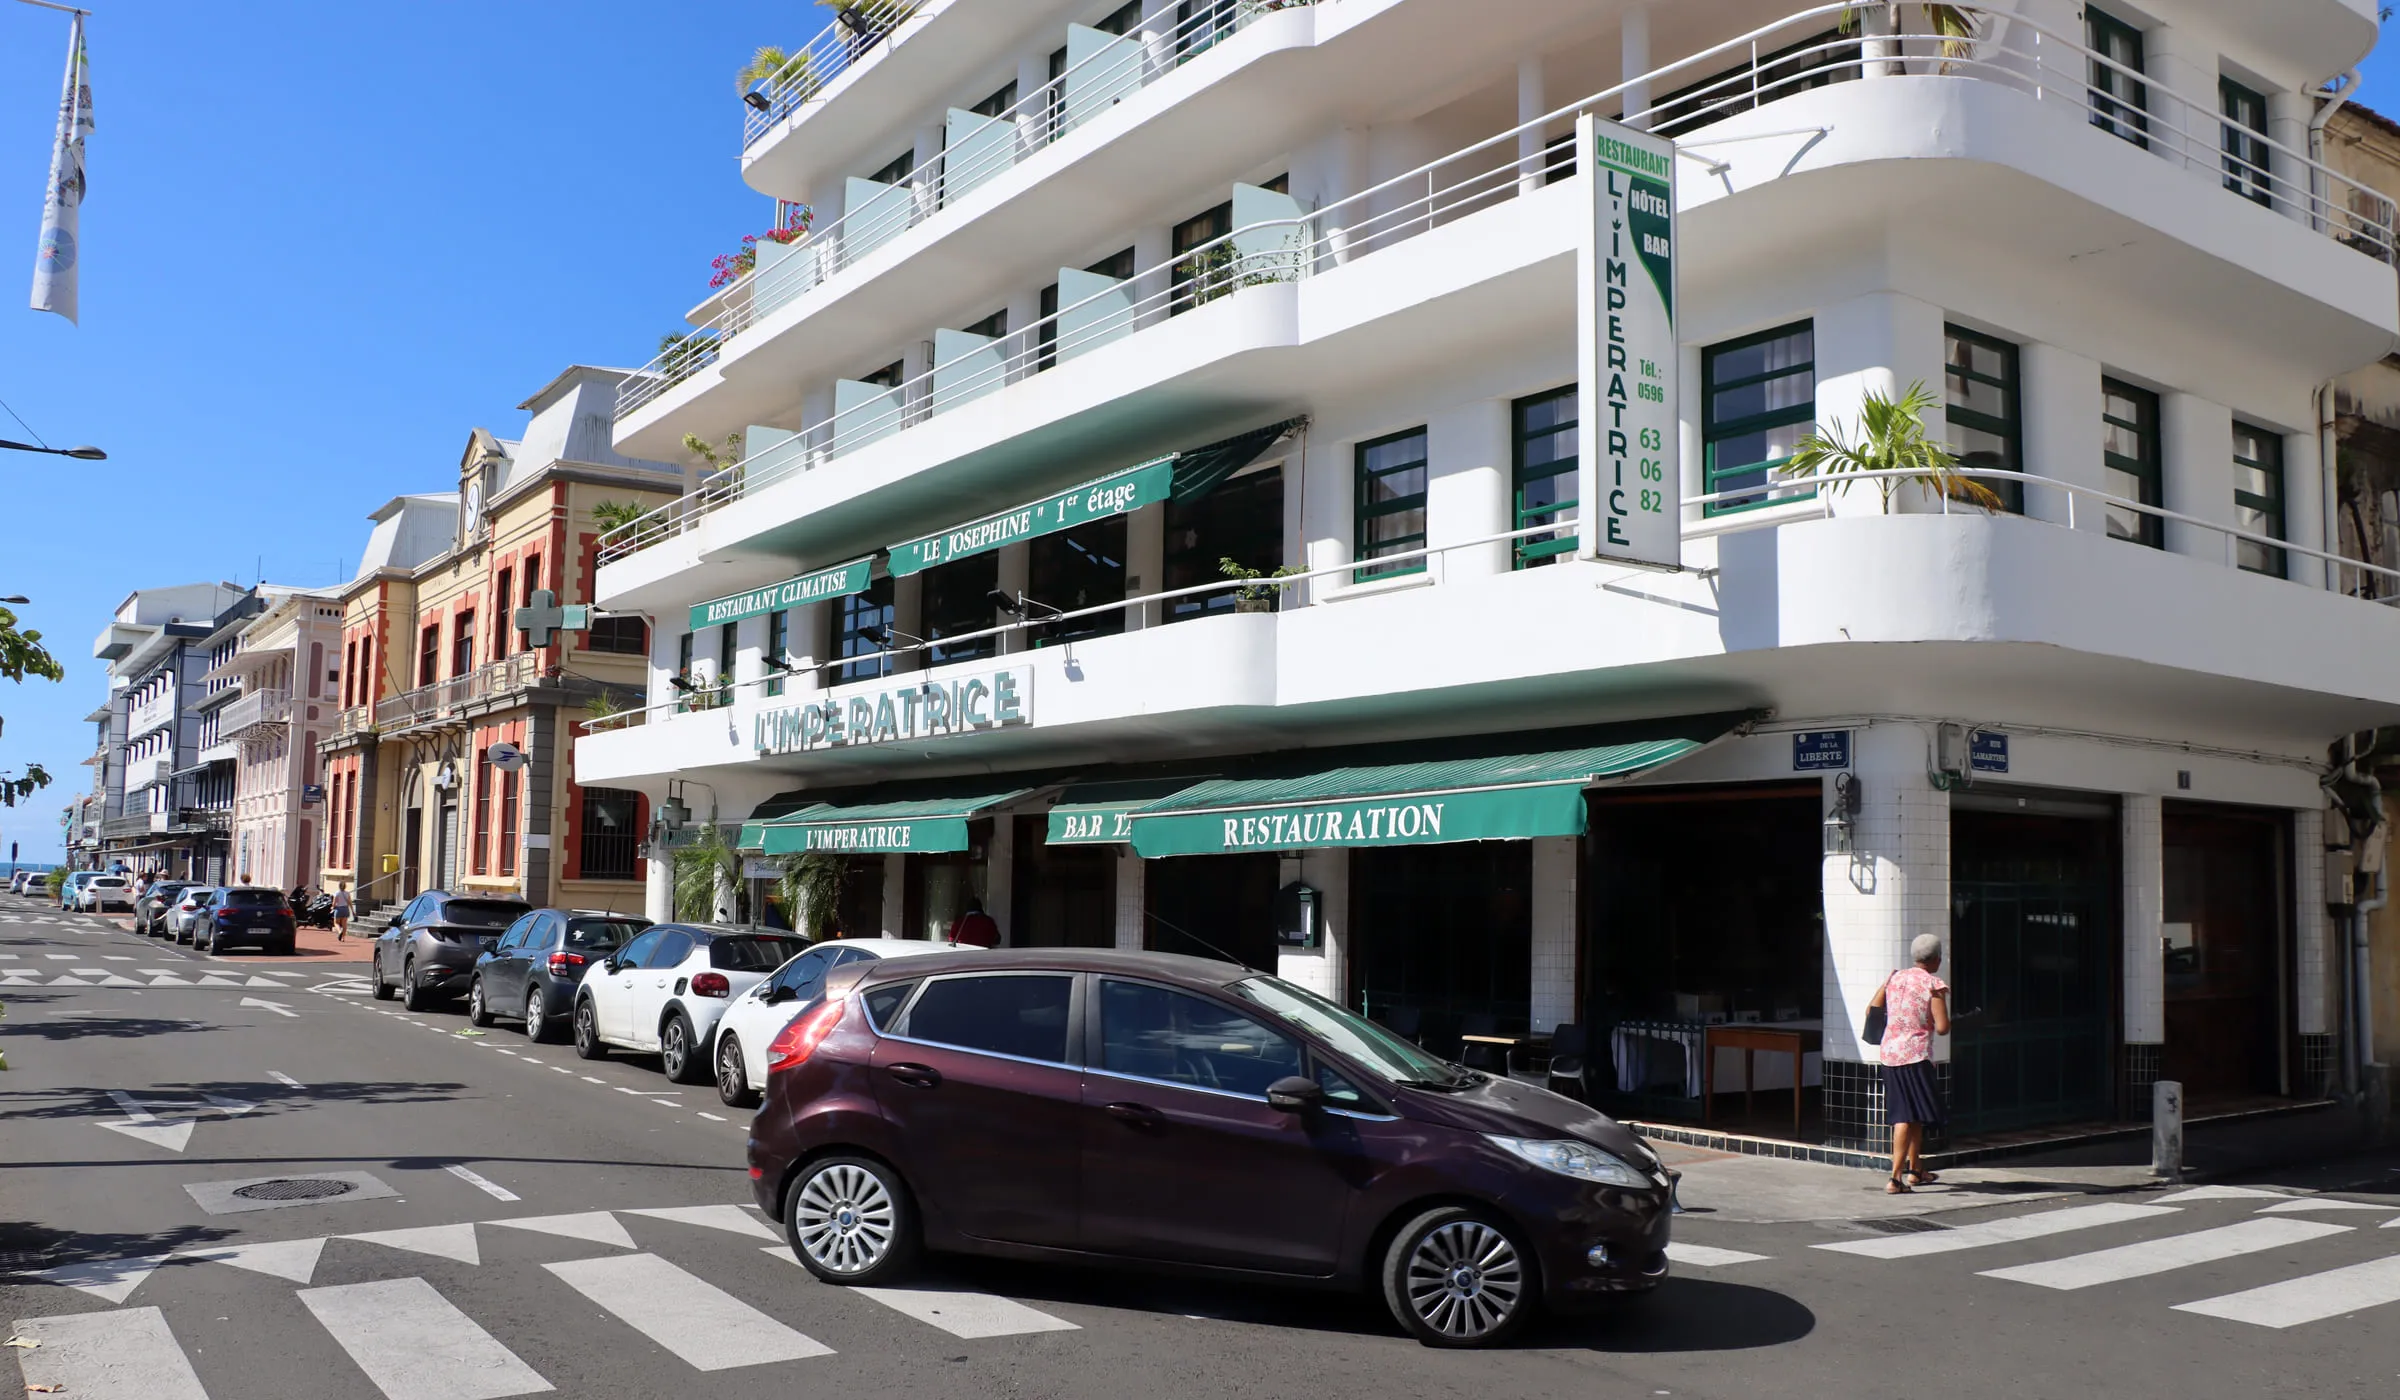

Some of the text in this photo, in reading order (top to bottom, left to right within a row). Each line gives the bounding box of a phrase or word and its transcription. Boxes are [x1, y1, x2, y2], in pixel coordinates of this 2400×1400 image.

[1598, 134, 1670, 177] RESTAURANT
[1631, 189, 1669, 219] HÔTEL
[1643, 233, 1669, 259] BAR
[1606, 170, 1630, 547] L'IMPERATRICE
[1637, 382, 1664, 403] 0596
[1639, 427, 1661, 451] 63
[1640, 457, 1662, 482] 06
[1640, 489, 1662, 513] 82
[922, 539, 941, 563] LE
[945, 510, 1031, 561] JOSEPHINE
[1087, 482, 1136, 512] étage
[707, 570, 848, 622] RESTAURANT CLIMATISE
[753, 671, 1019, 751] L'IMPERATRICE
[1799, 751, 1843, 762] LIBERTE
[806, 825, 911, 850] L'IMPERATRICE
[1062, 814, 1103, 838] BAR
[1223, 803, 1445, 847] RESTAURATION
